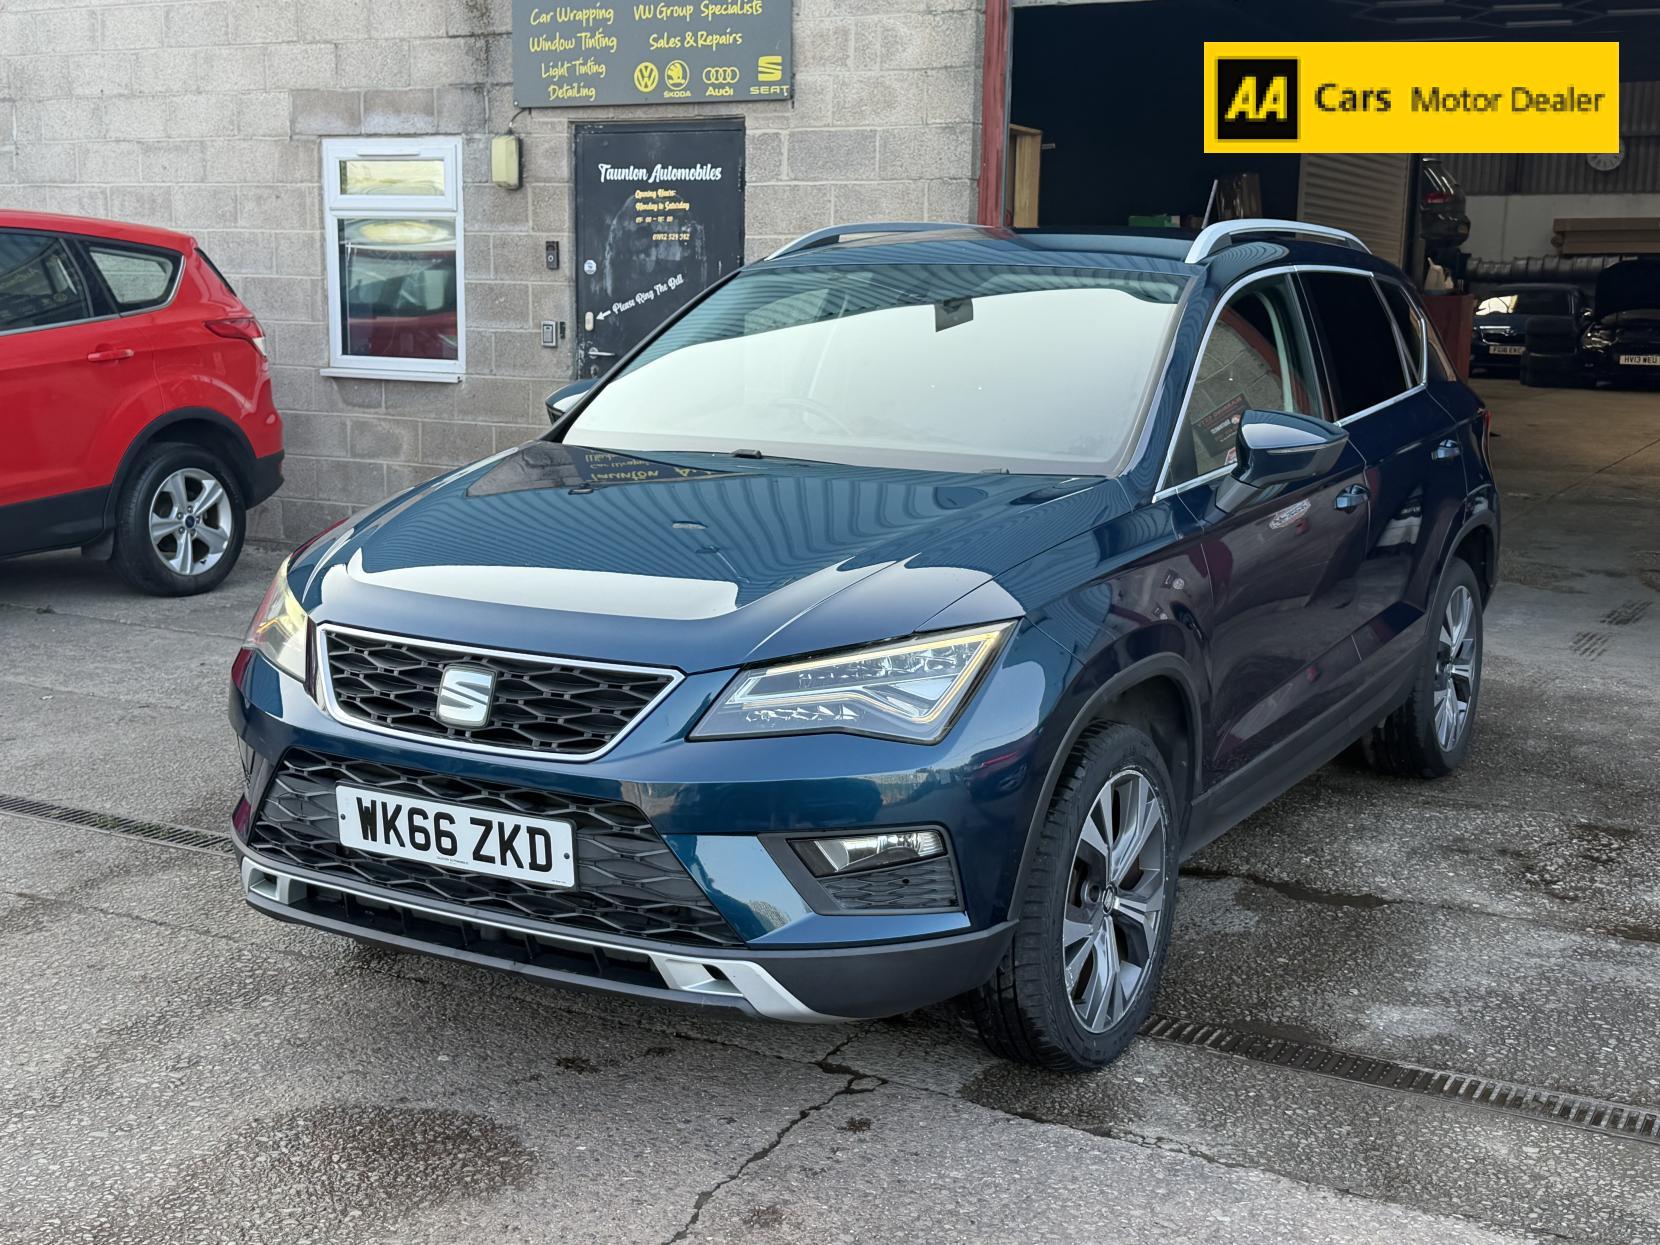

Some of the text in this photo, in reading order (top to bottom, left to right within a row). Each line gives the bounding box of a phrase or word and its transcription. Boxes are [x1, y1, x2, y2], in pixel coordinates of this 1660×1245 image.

[530, 5, 614, 27] Car Wrapping
[633, 0, 764, 22] VW Group Specialists
[529, 28, 617, 53] Window Tinting
[649, 28, 743, 51] Sales & Repairs
[541, 57, 606, 81] Light Tinting
[548, 82, 596, 101] Detailing
[706, 86, 733, 97] Audi
[749, 85, 790, 95] SEAT
[598, 163, 722, 183] Taunton Automobiles
[612, 273, 684, 315] Please Ring The Bell
[356, 797, 553, 872] WK66 ZKD
